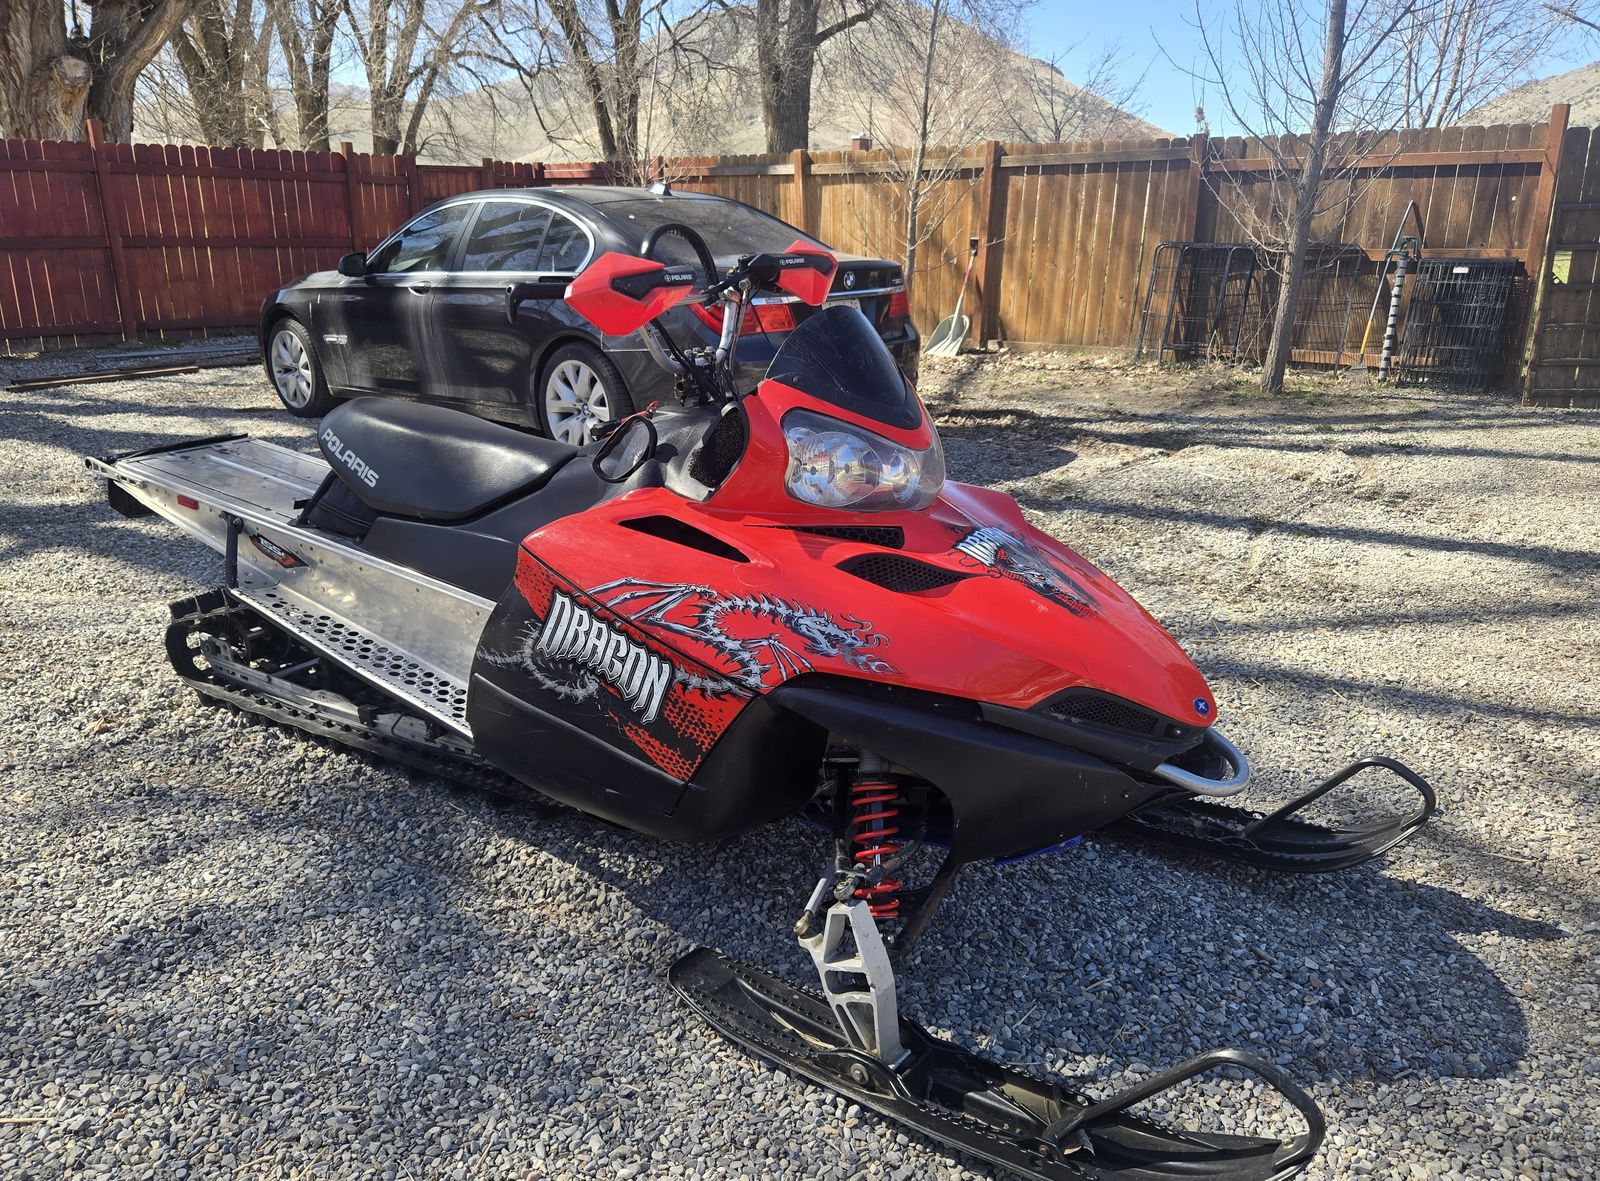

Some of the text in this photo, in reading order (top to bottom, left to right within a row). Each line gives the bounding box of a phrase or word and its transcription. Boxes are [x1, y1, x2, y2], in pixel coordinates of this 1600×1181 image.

[321, 427, 380, 488] POLARIS
[954, 526, 1026, 567] DRA
[536, 590, 672, 724] DRAGON
